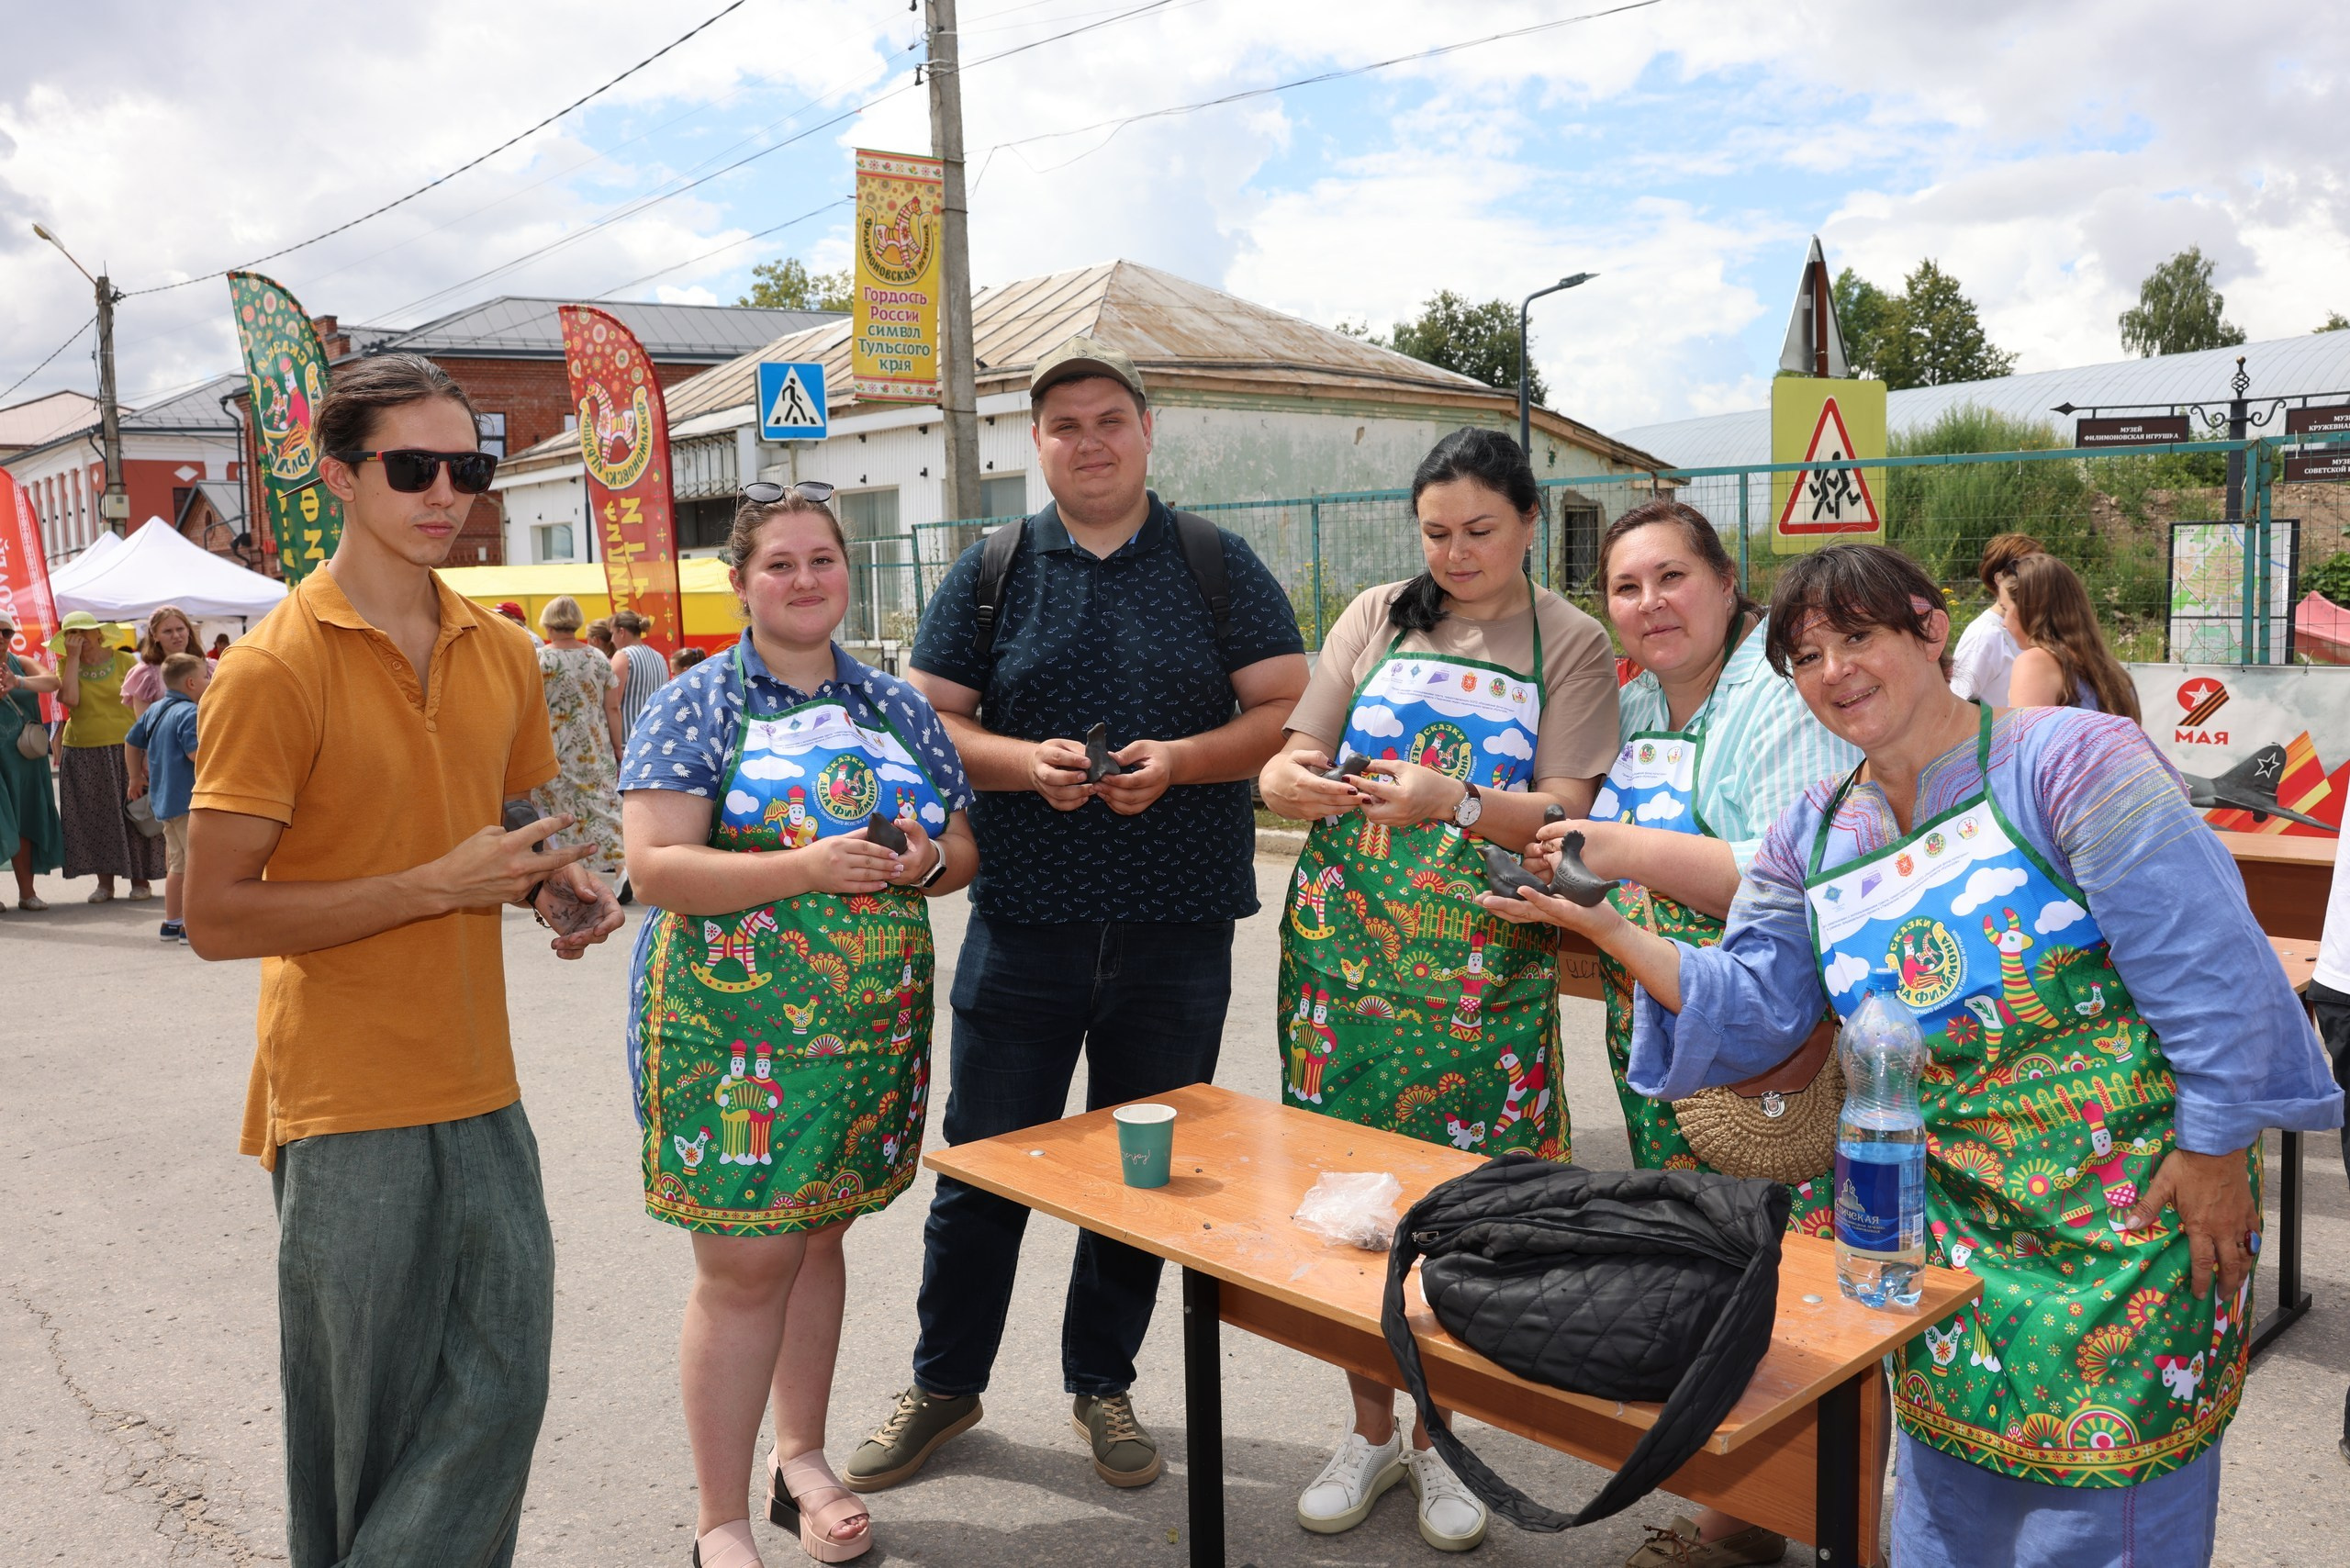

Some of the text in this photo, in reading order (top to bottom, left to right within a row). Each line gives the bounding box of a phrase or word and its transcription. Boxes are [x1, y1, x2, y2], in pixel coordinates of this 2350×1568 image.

[864, 218, 917, 281] ФИЛИМОНОВСКАЯ
[864, 286, 927, 305] Гордость
[870, 306, 919, 322] России
[867, 324, 921, 339] символ
[857, 338, 931, 357] Тульского
[2309, 422, 2350, 431] КРУЖЕВНА
[2333, 414, 2350, 422] МУЗ
[2084, 433, 2144, 442] ФИЛИМОНОВСКАЯ
[2120, 425, 2143, 433] МУЗЕЙ
[2304, 465, 2346, 475] СОВЕТСКОЙ
[1424, 723, 1465, 742] СКАЗКИ
[2175, 729, 2229, 745] МАЯ
[825, 755, 866, 774] СКАЗКИ
[820, 780, 832, 806] ДЕДА
[832, 779, 876, 818] ФИЛИМОНА
[1890, 918, 1931, 951] СКАЗКИ
[1914, 935, 1958, 1004] ФИЛИМОНА
